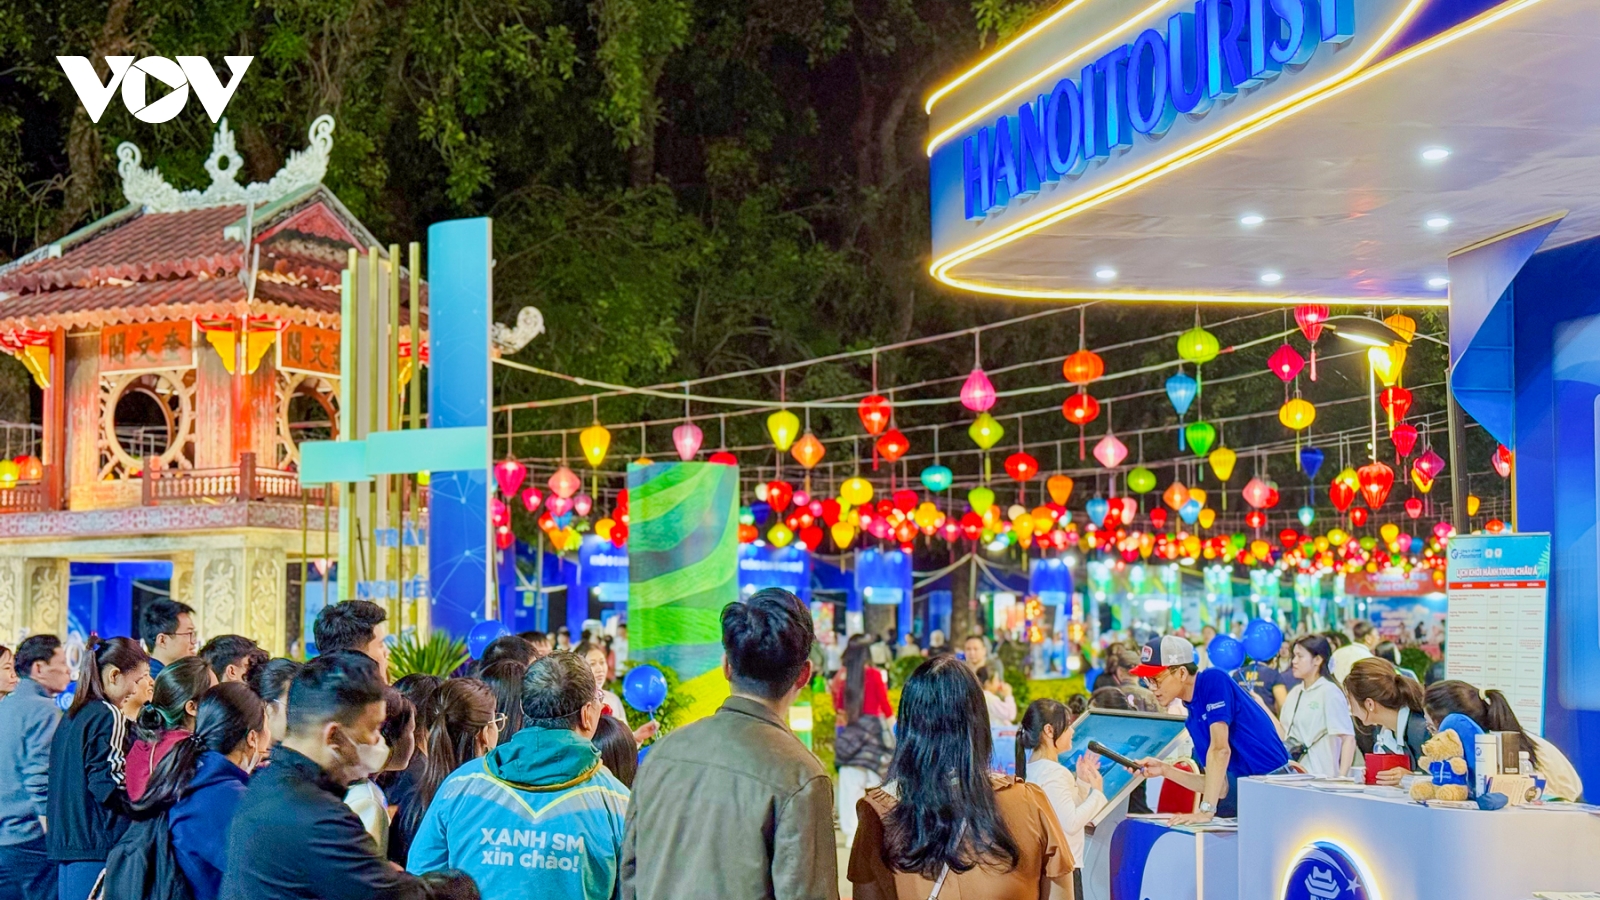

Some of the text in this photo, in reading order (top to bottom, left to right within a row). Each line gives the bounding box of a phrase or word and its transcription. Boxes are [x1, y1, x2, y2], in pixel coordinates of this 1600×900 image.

[1500, 567, 1515, 576] TOUR
[479, 827, 585, 853] XANH SM
[481, 847, 580, 873] xin chào!
